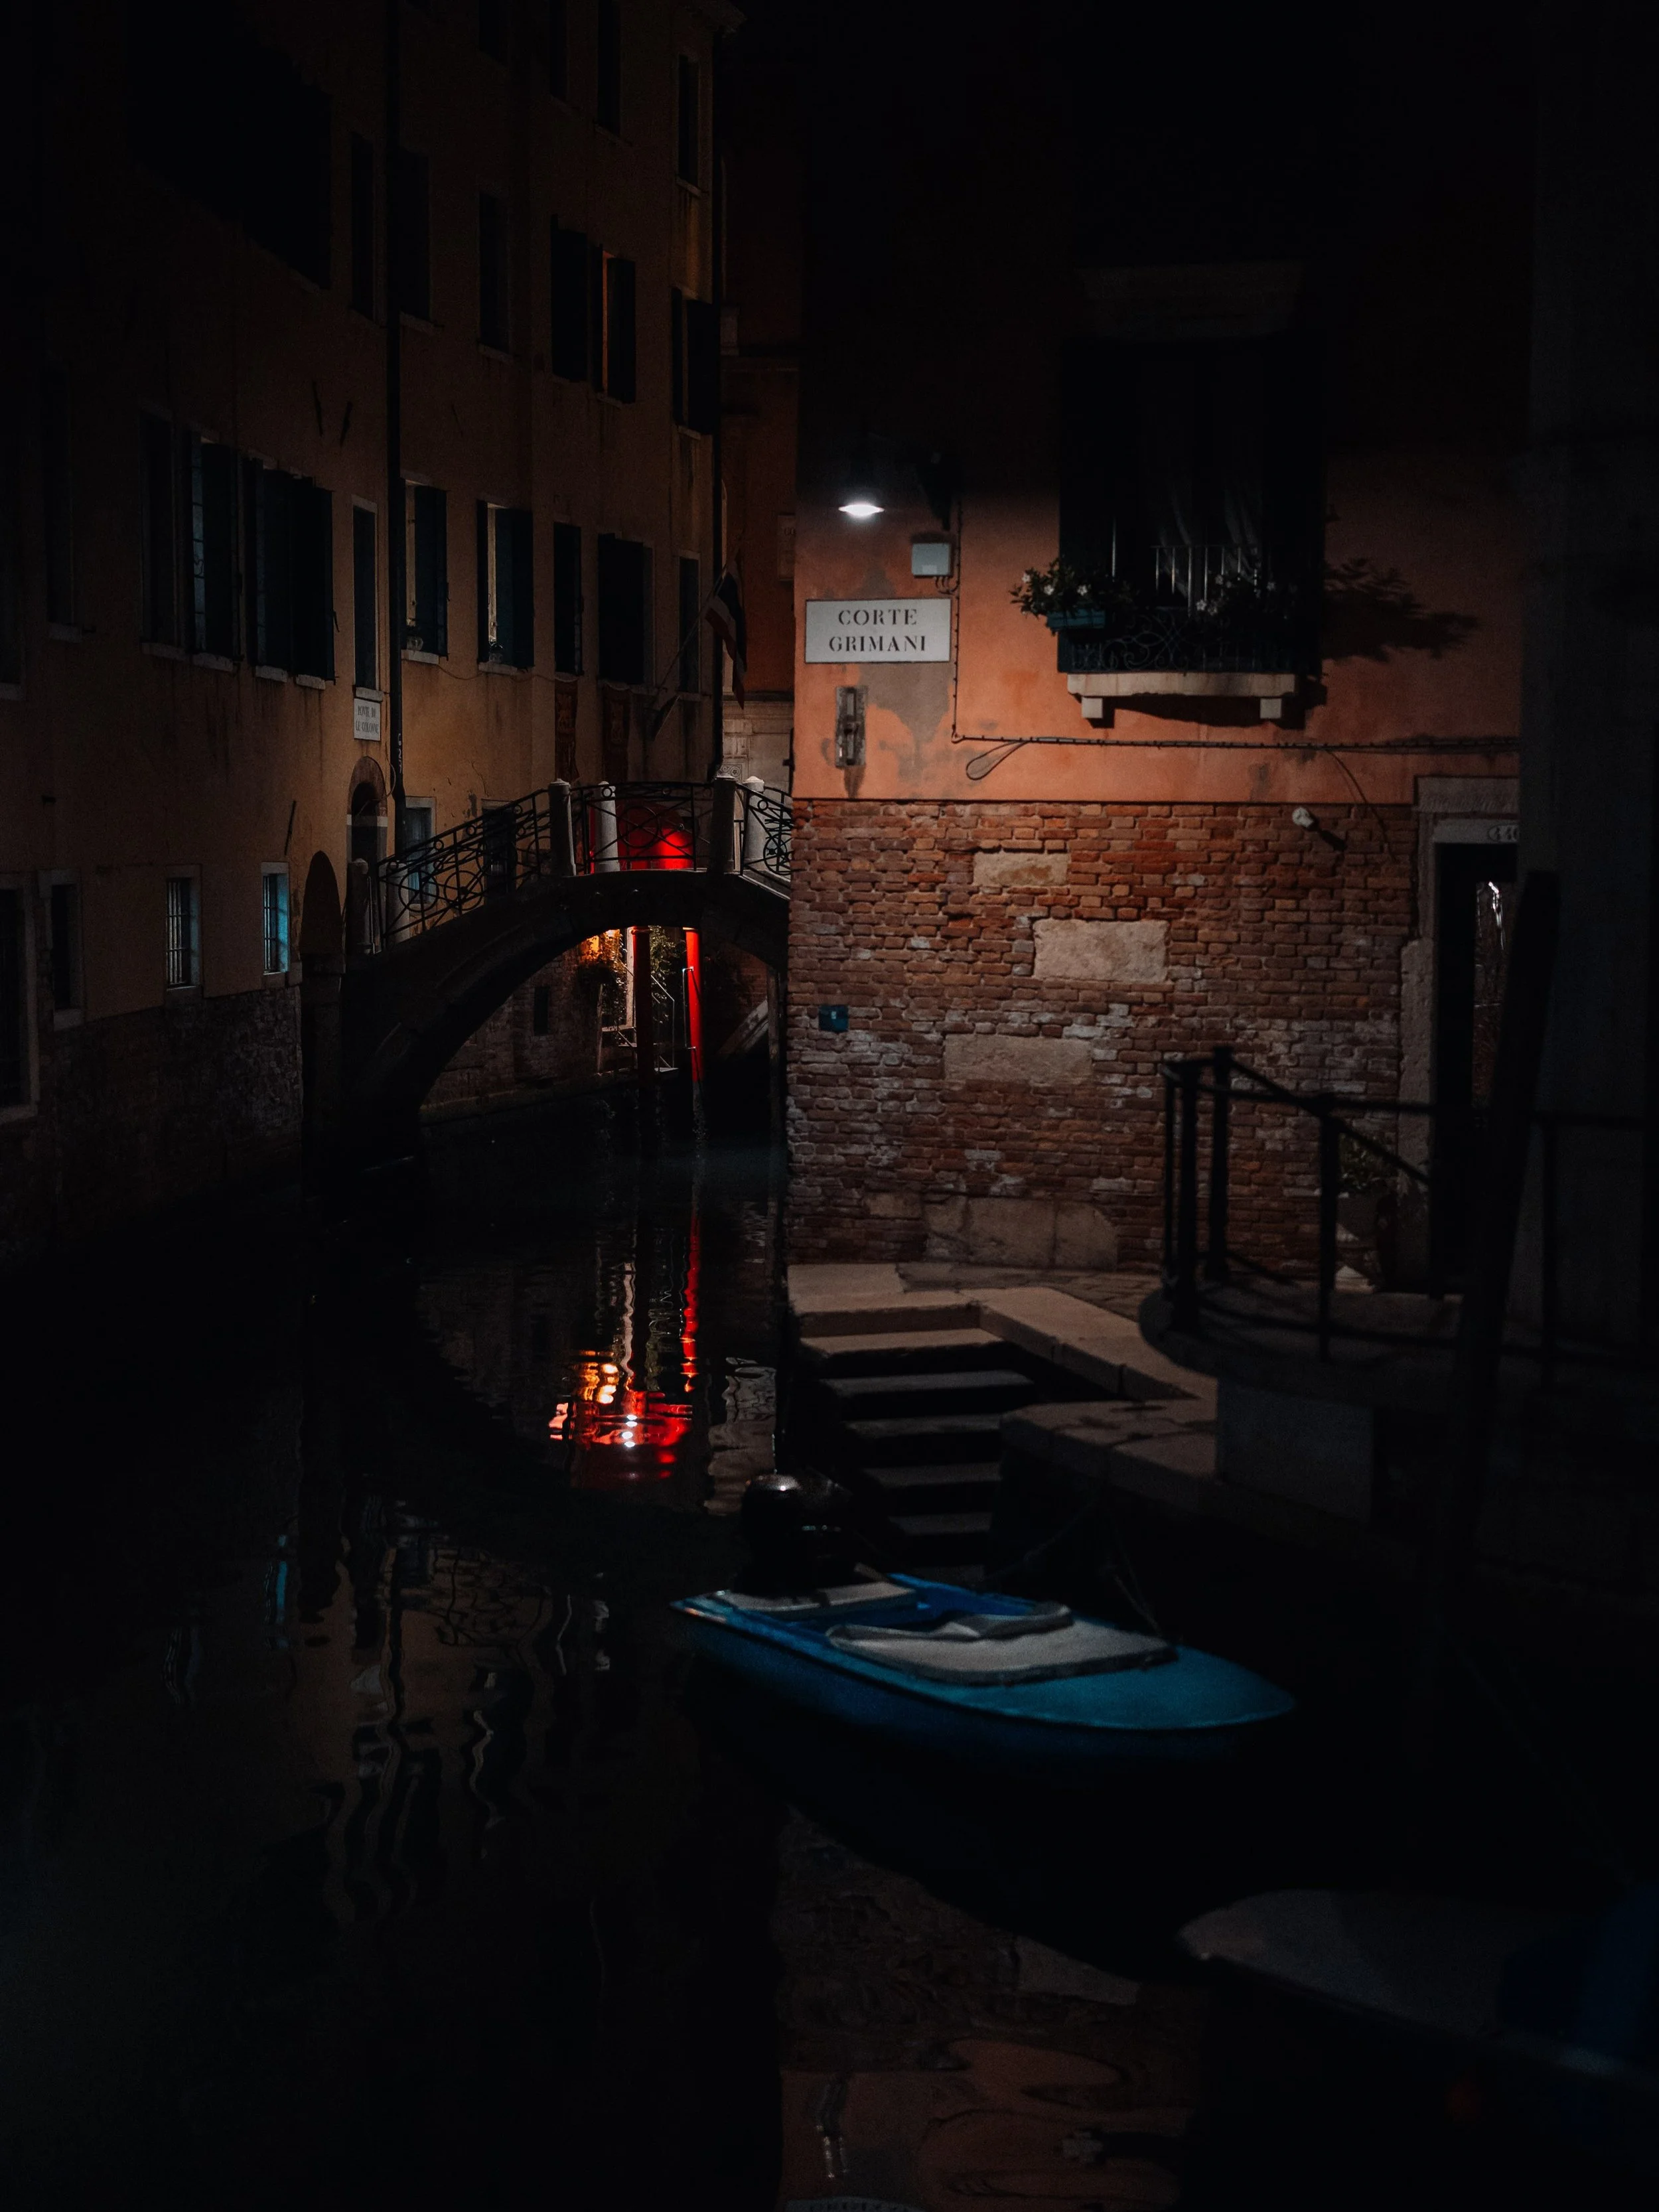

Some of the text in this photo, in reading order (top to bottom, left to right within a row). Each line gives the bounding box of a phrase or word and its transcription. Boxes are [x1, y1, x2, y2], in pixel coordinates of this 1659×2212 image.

[838, 609, 917, 625] CORTE
[829, 635, 926, 652] GRIMANI
[358, 705, 370, 717] PONTE
[356, 721, 360, 731] LE
